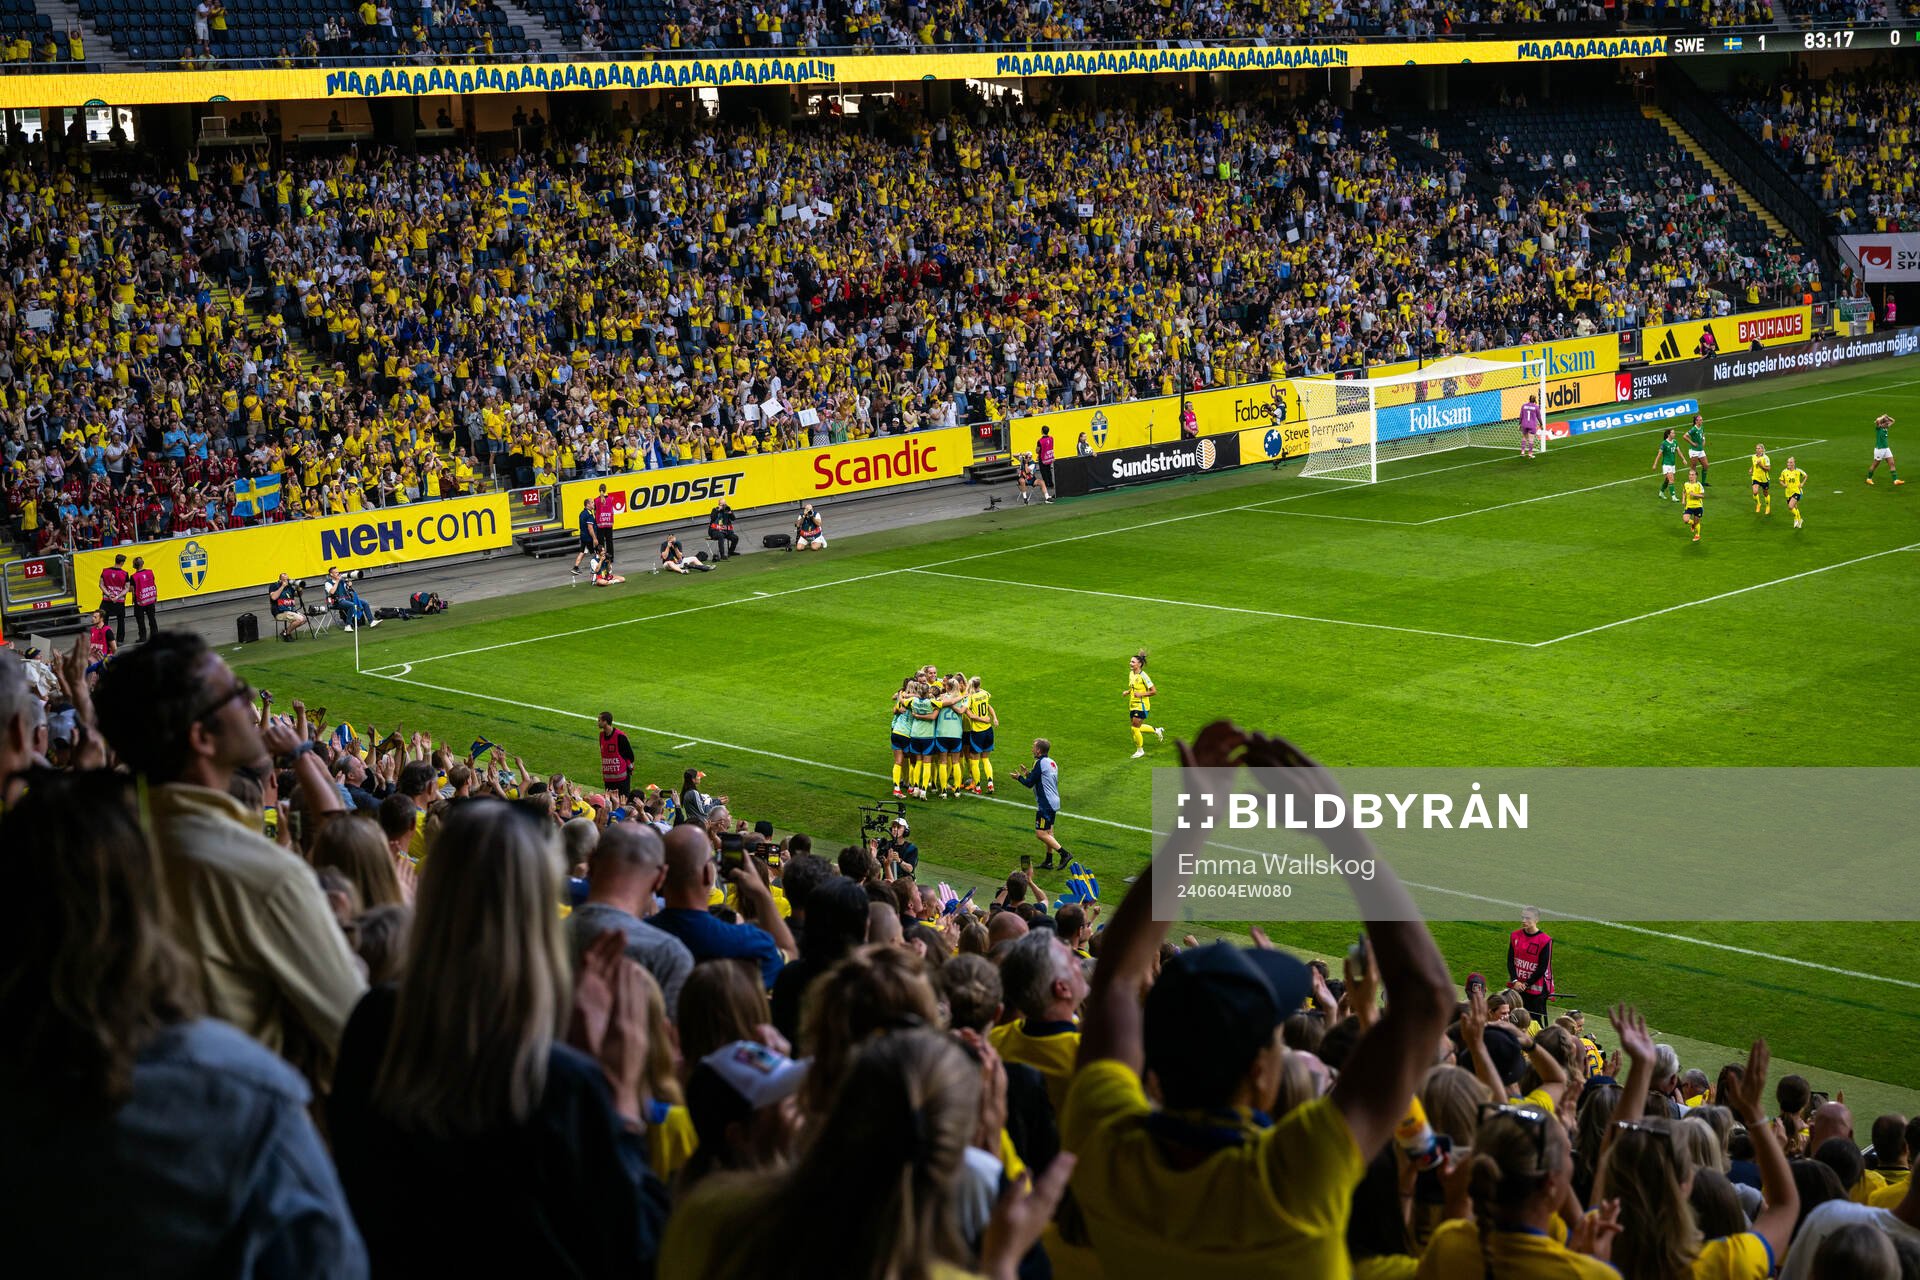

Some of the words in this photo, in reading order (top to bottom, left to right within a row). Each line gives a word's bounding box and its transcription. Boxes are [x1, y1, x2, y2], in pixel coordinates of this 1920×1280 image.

[1674, 37, 1705, 53] SWE
[1758, 35, 1766, 52] 1
[1804, 31, 1854, 50] 83:17
[1890, 30, 1900, 46] 0
[1739, 315, 1803, 341] BAUHAUS
[1521, 347, 1595, 380] Folksam
[1713, 363, 1732, 381] När
[1733, 361, 1746, 376] du
[1747, 358, 1777, 377] spelar
[1778, 355, 1796, 369] hos
[1798, 353, 1813, 367] oss
[1815, 350, 1832, 367] gör
[1833, 345, 1845, 360] du
[1846, 341, 1886, 358] drömmar
[1887, 333, 1918, 354] möjliga
[1633, 373, 1668, 388] SVENSKA
[1633, 388, 1652, 400] SPEL
[1409, 405, 1472, 433] Folksam
[1582, 416, 1622, 431] Heja
[1624, 403, 1690, 424] Sverige!
[980, 427, 991, 436] 121
[1284, 428, 1310, 442] Steve
[1311, 420, 1355, 438] Perryman
[814, 440, 938, 490] Scandic
[1112, 449, 1196, 479] Sundström
[524, 493, 539, 502] 122
[629, 473, 744, 511] ODDSET
[26, 564, 44, 575] 123
[977, 702, 988, 718] 10
